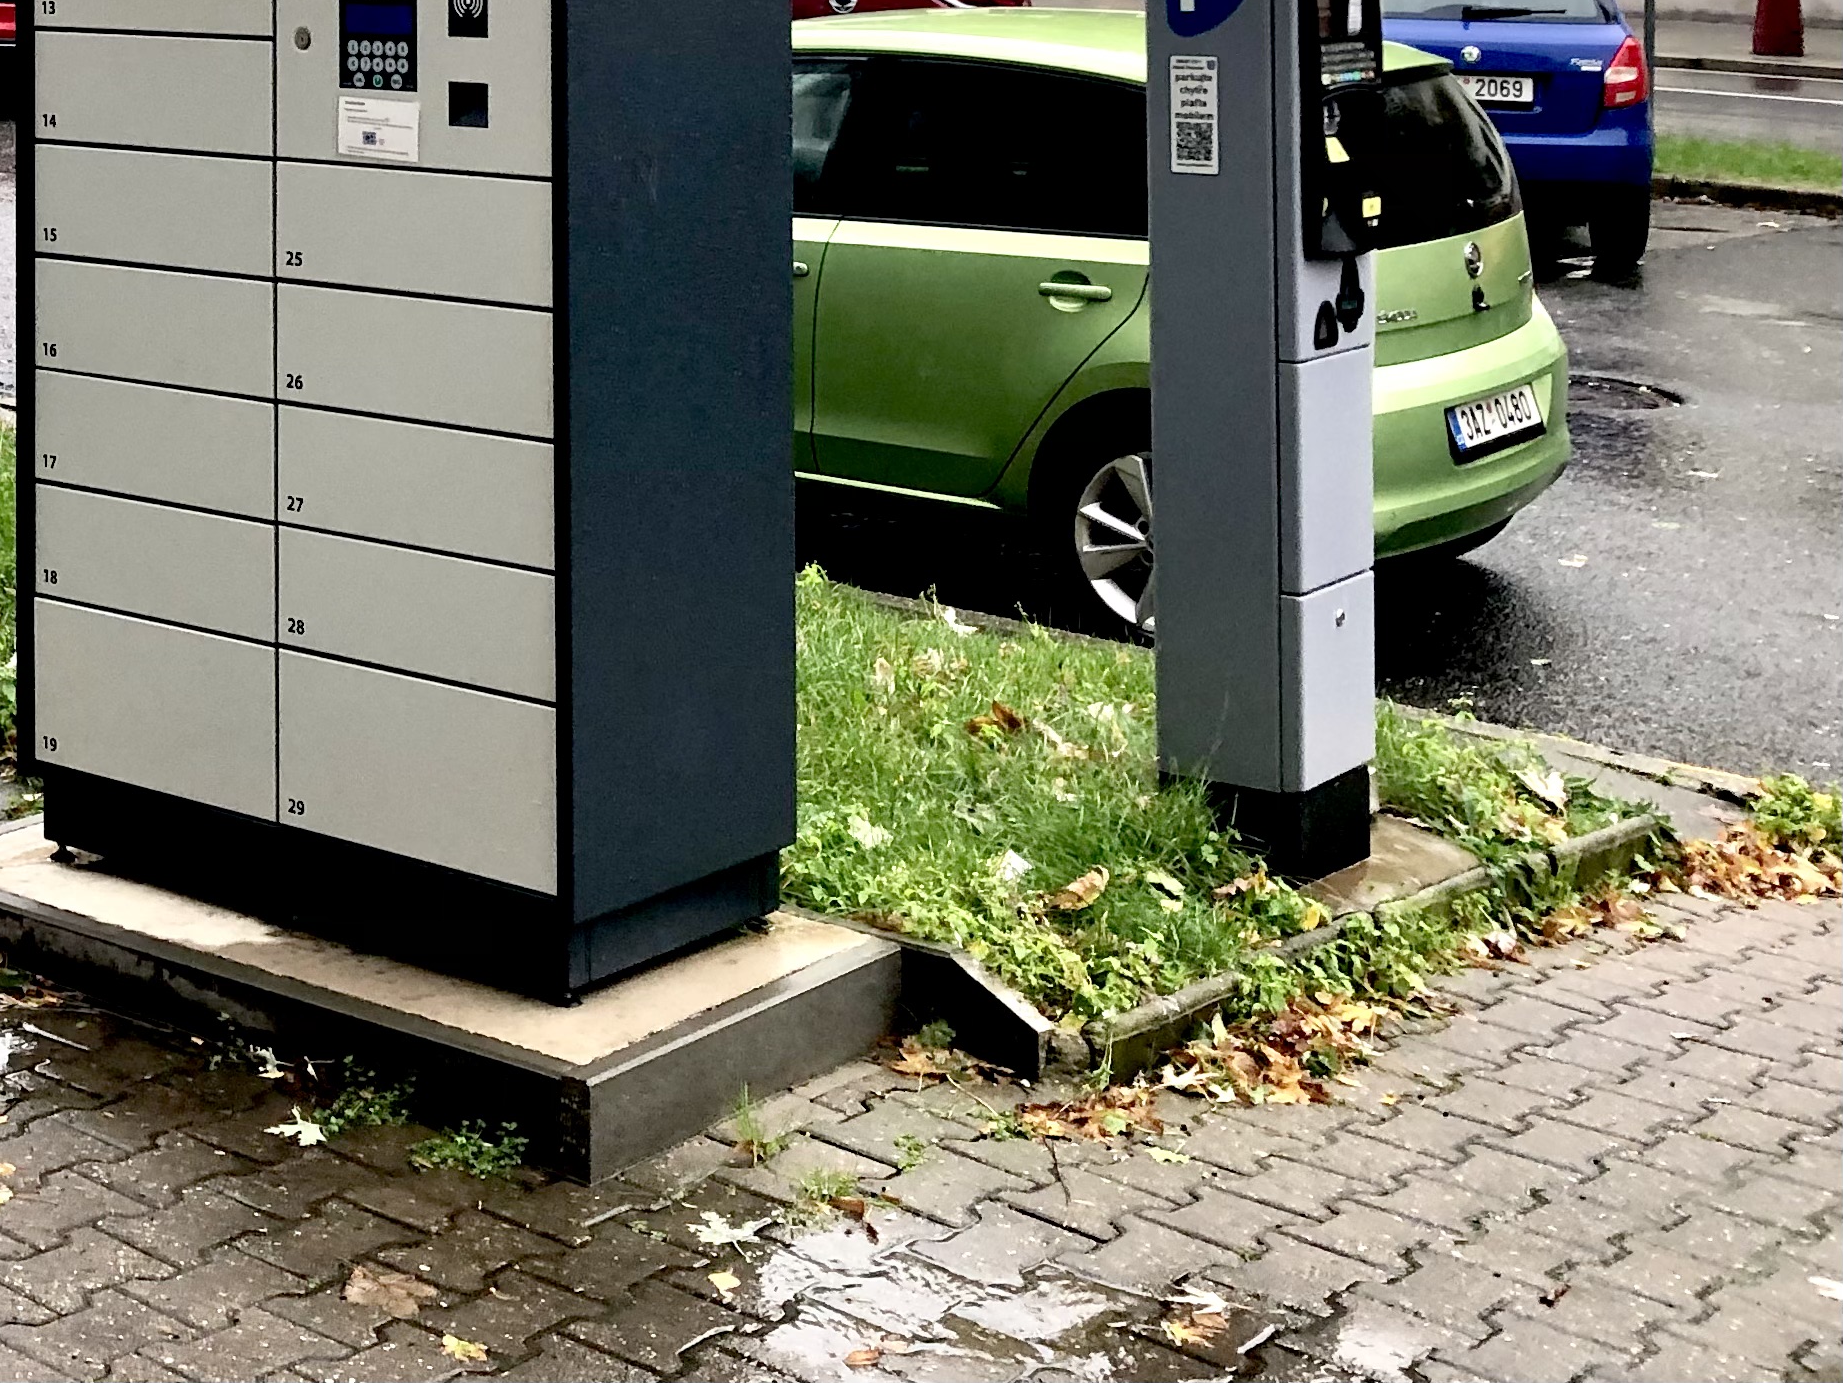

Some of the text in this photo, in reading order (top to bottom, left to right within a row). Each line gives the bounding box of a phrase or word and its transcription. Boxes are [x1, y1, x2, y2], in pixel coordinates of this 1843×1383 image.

[41, 0, 56, 15] 13
[1474, 78, 1524, 98] 2069
[42, 113, 57, 128] 14
[43, 227, 58, 243] 15
[285, 250, 303, 267] 25
[42, 342, 58, 358] 16
[285, 373, 304, 390] 26
[1460, 390, 1532, 440] 3AZ 0480
[42, 453, 57, 470] 17
[286, 495, 304, 513] 27
[43, 568, 58, 585] 18
[287, 617, 306, 636] 28
[42, 735, 58, 752] 19
[287, 798, 305, 817] 29
